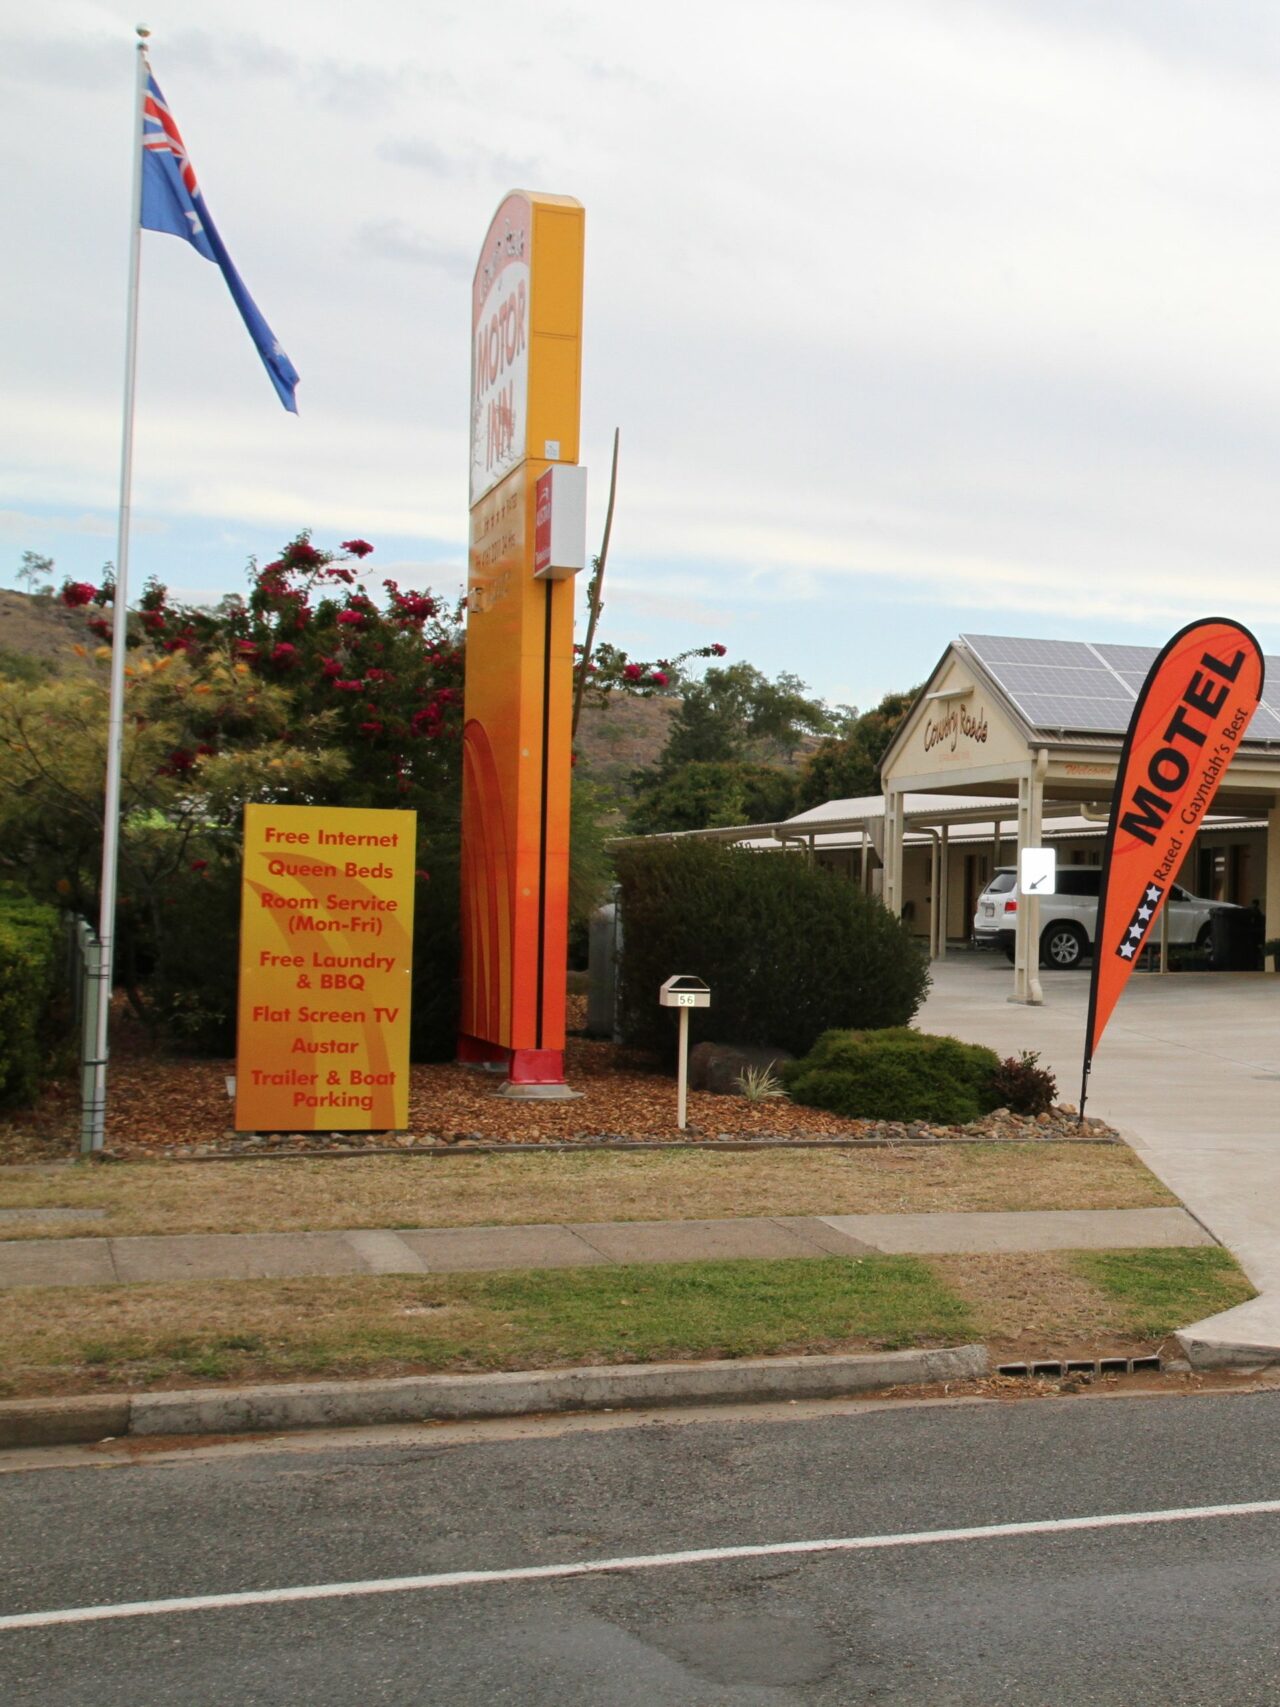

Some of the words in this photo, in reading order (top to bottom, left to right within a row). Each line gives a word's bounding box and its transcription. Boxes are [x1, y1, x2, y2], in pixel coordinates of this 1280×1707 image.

[476, 278, 526, 401] MOTOR
[486, 379, 513, 472] INN
[924, 699, 958, 752] Country
[960, 703, 988, 744] Roads
[1119, 647, 1247, 847] MOTEL
[1154, 838, 1183, 882] Rated
[1182, 742, 1232, 827] Gayndah's
[1222, 706, 1250, 742] Best
[265, 827, 310, 845] Free
[317, 829, 399, 848] Internet
[267, 859, 337, 878] Queen
[344, 862, 394, 879] Beds
[261, 892, 319, 910] Room
[326, 894, 398, 912] Service
[288, 915, 383, 936] (Mon-Fri)
[259, 950, 305, 968] Free
[312, 952, 396, 973] Laundry
[296, 974, 312, 990] &
[320, 974, 366, 992] BBQ
[680, 996, 693, 1004] 56
[252, 1005, 291, 1023] Flat
[297, 1005, 366, 1023] Screen
[373, 1007, 399, 1023] TV
[291, 1037, 360, 1054] Austar
[251, 1069, 319, 1086] Trailer
[326, 1070, 342, 1086] &
[349, 1069, 397, 1086] Boat
[292, 1091, 374, 1111] Parking
